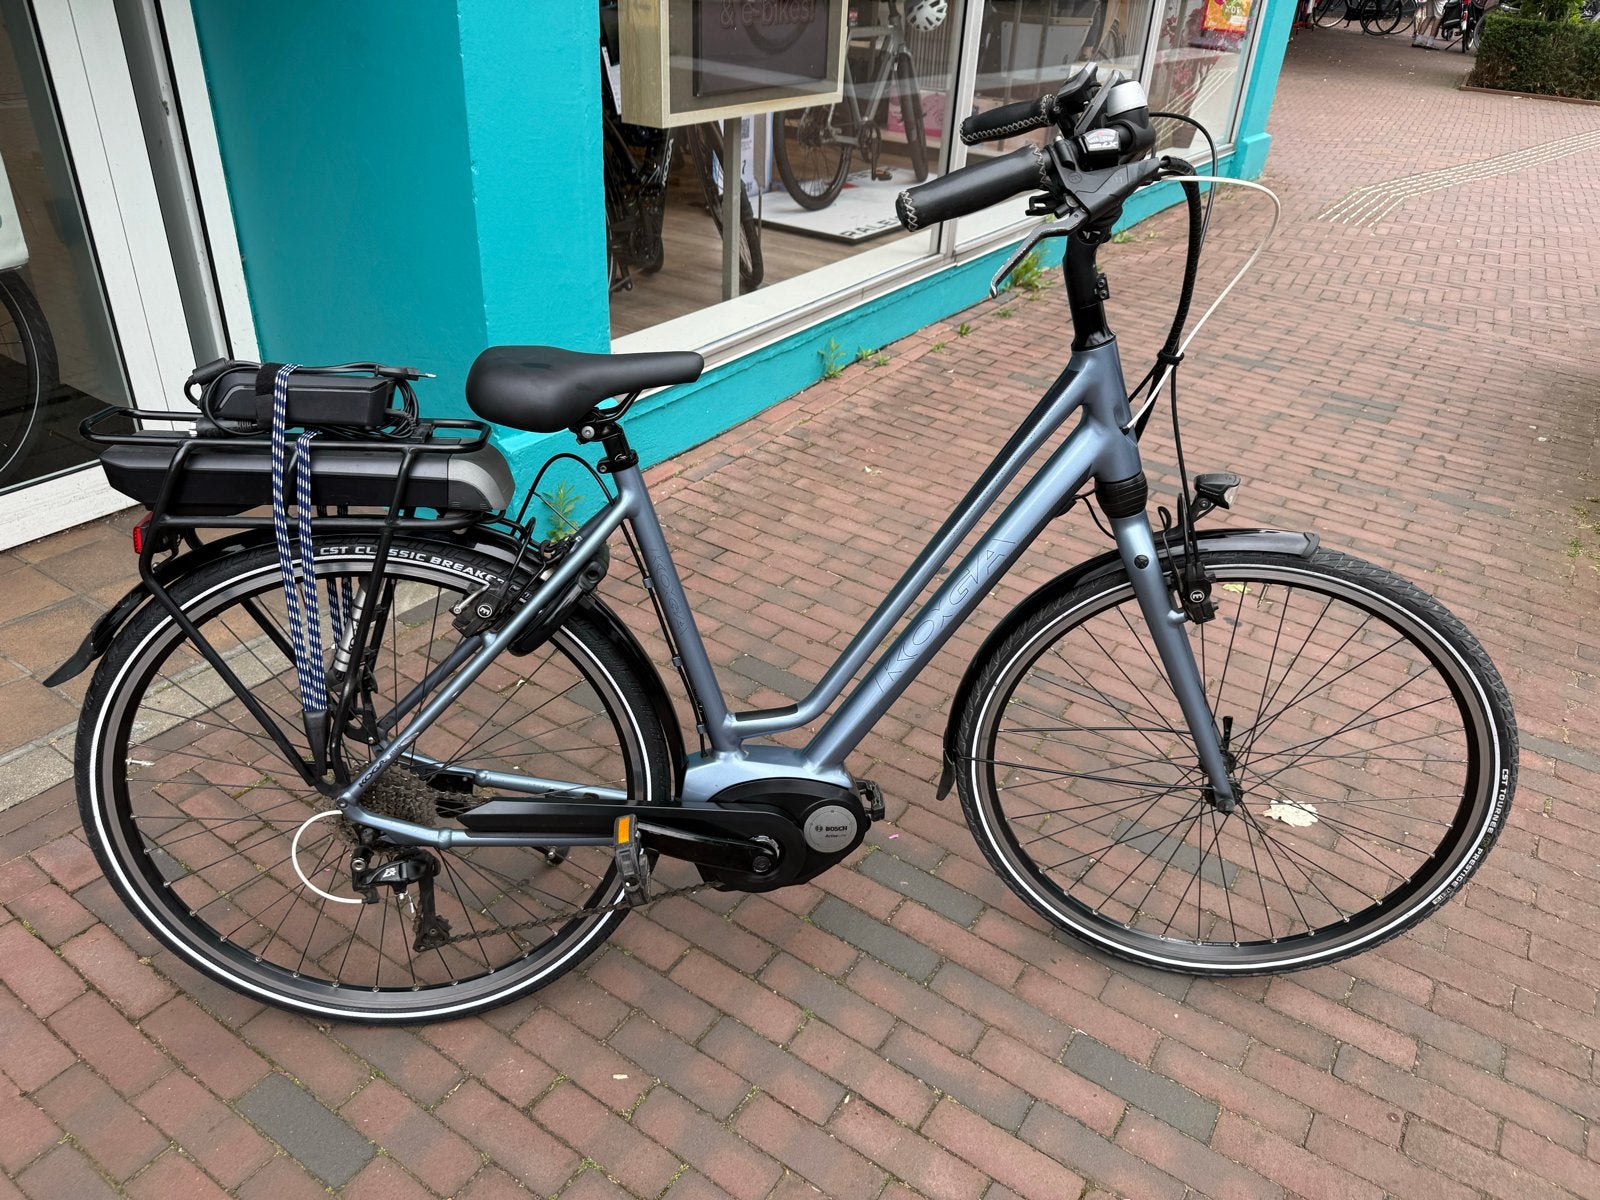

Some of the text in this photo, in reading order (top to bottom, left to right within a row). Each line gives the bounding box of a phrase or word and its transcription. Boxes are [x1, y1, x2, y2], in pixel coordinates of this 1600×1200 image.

[320, 546, 349, 555] CST
[354, 546, 425, 562] CLSSIC
[652, 555, 688, 635] KOGA
[874, 538, 1017, 692] KOGA
[358, 760, 388, 787] KOGA
[1501, 768, 1509, 785] CST
[1451, 847, 1483, 888] PRESTIGE
